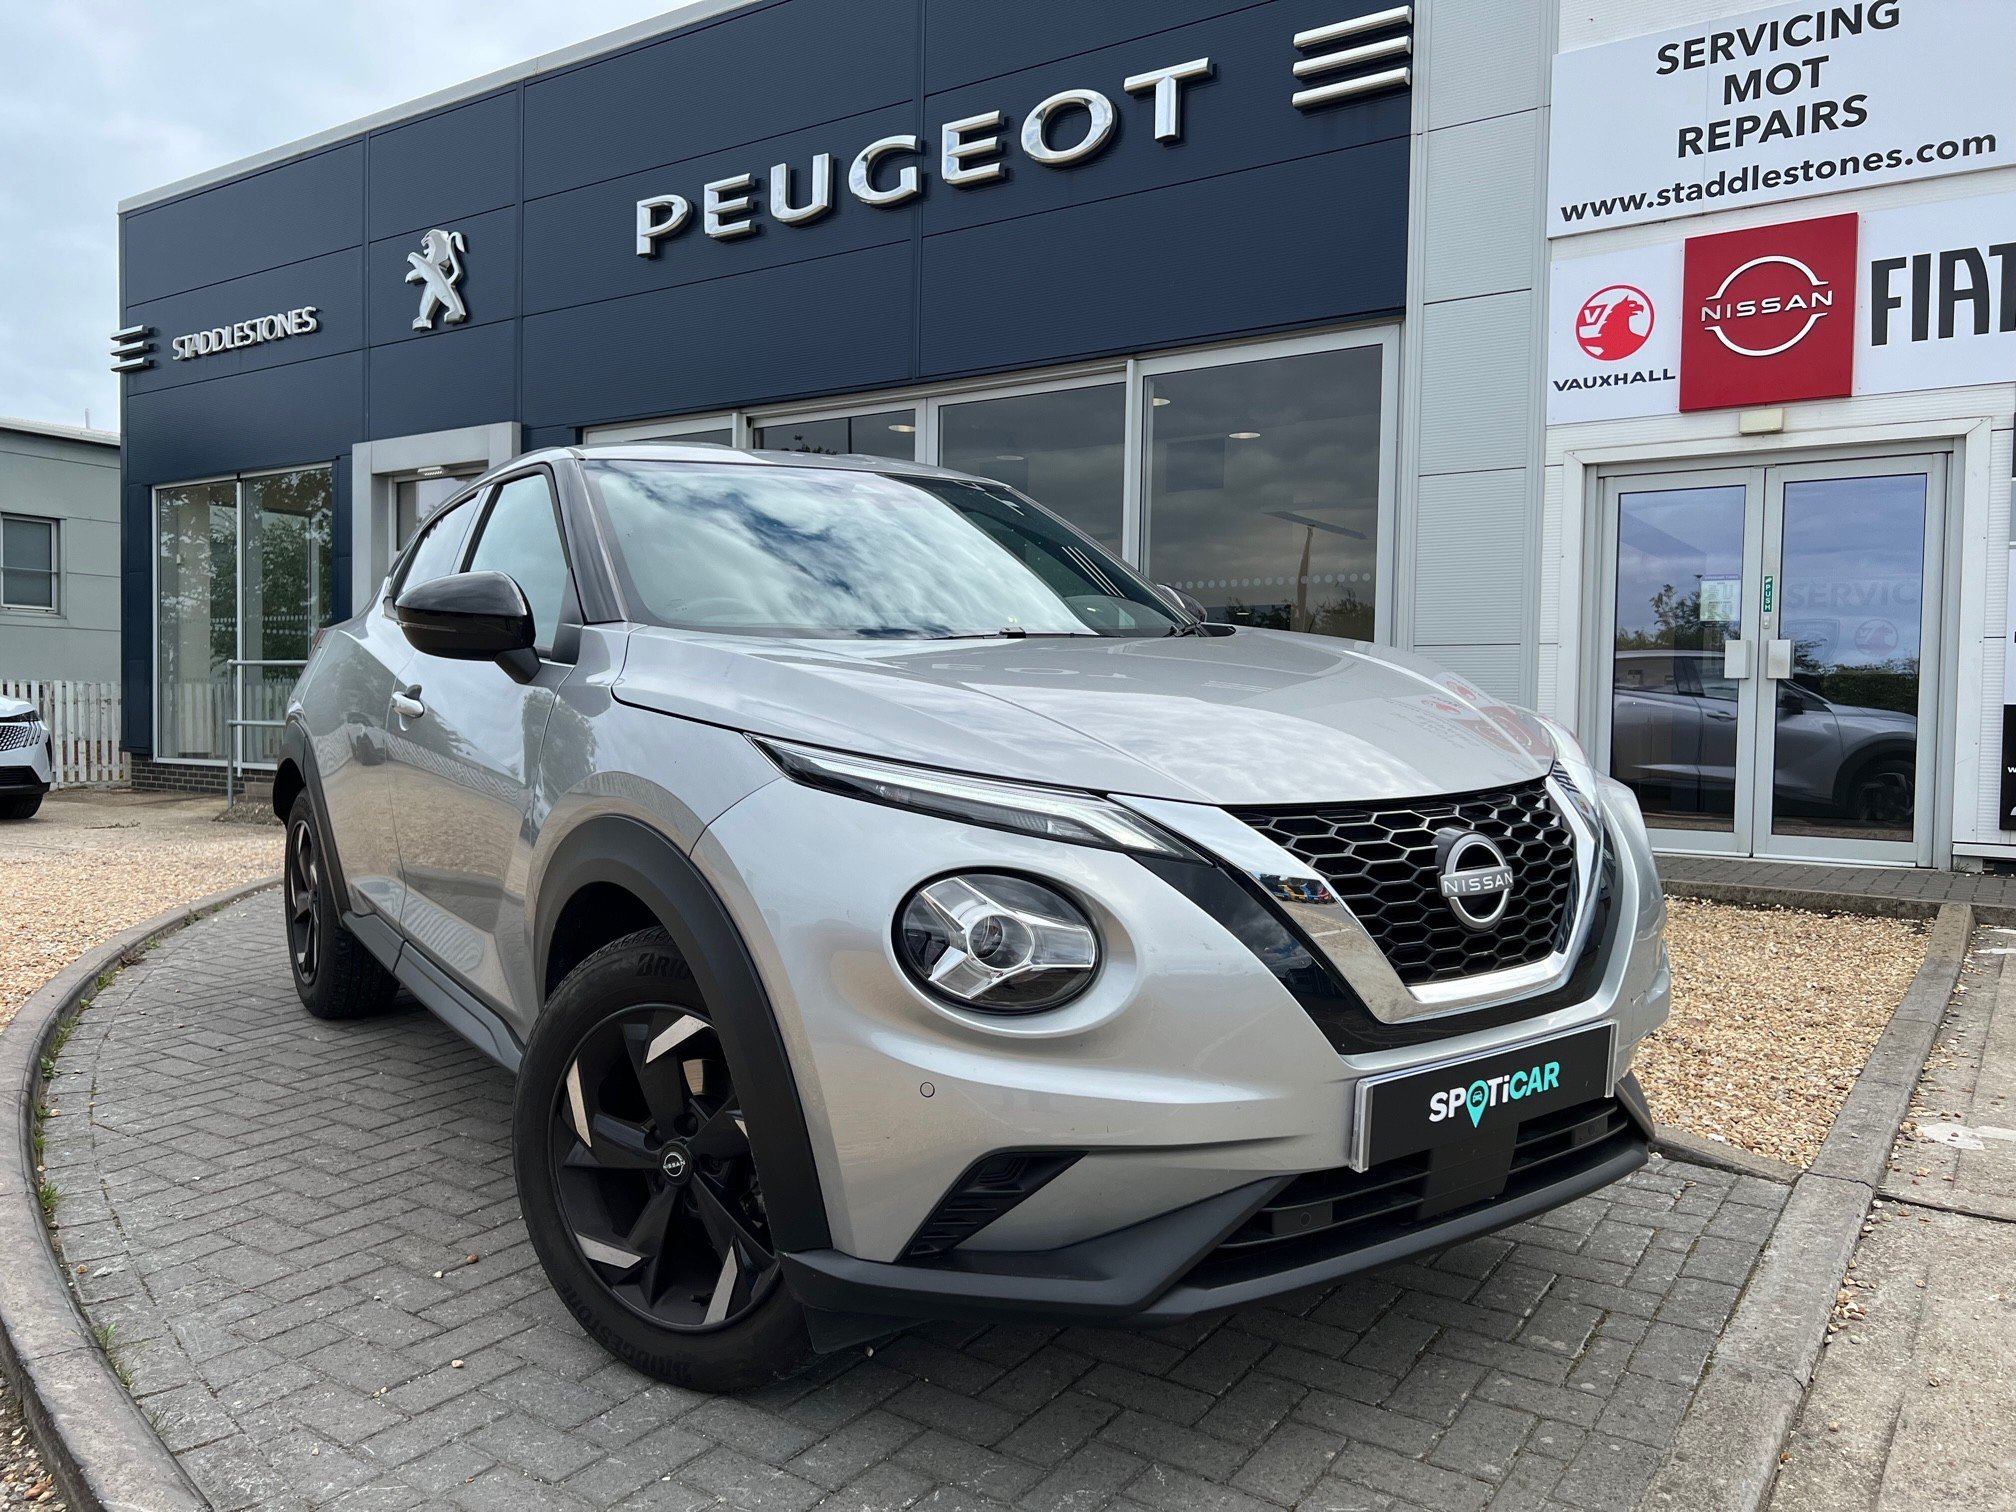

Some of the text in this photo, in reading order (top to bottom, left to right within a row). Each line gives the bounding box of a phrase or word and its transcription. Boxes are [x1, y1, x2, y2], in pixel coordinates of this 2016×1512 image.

[1655, 0, 1901, 75] SERVICING
[1723, 55, 1830, 106] MOT
[1677, 94, 1868, 158] REPAIRS
[635, 57, 1212, 258] PEUGEOT
[1560, 132, 1996, 222] www.staddlestones.com
[1700, 289, 1833, 322] NISSAN
[1871, 241, 2016, 347] FIAT
[171, 305, 318, 361] STADDLESTONES
[1552, 367, 1676, 392] VAUXHALL
[1443, 871, 1514, 895] NISSAN
